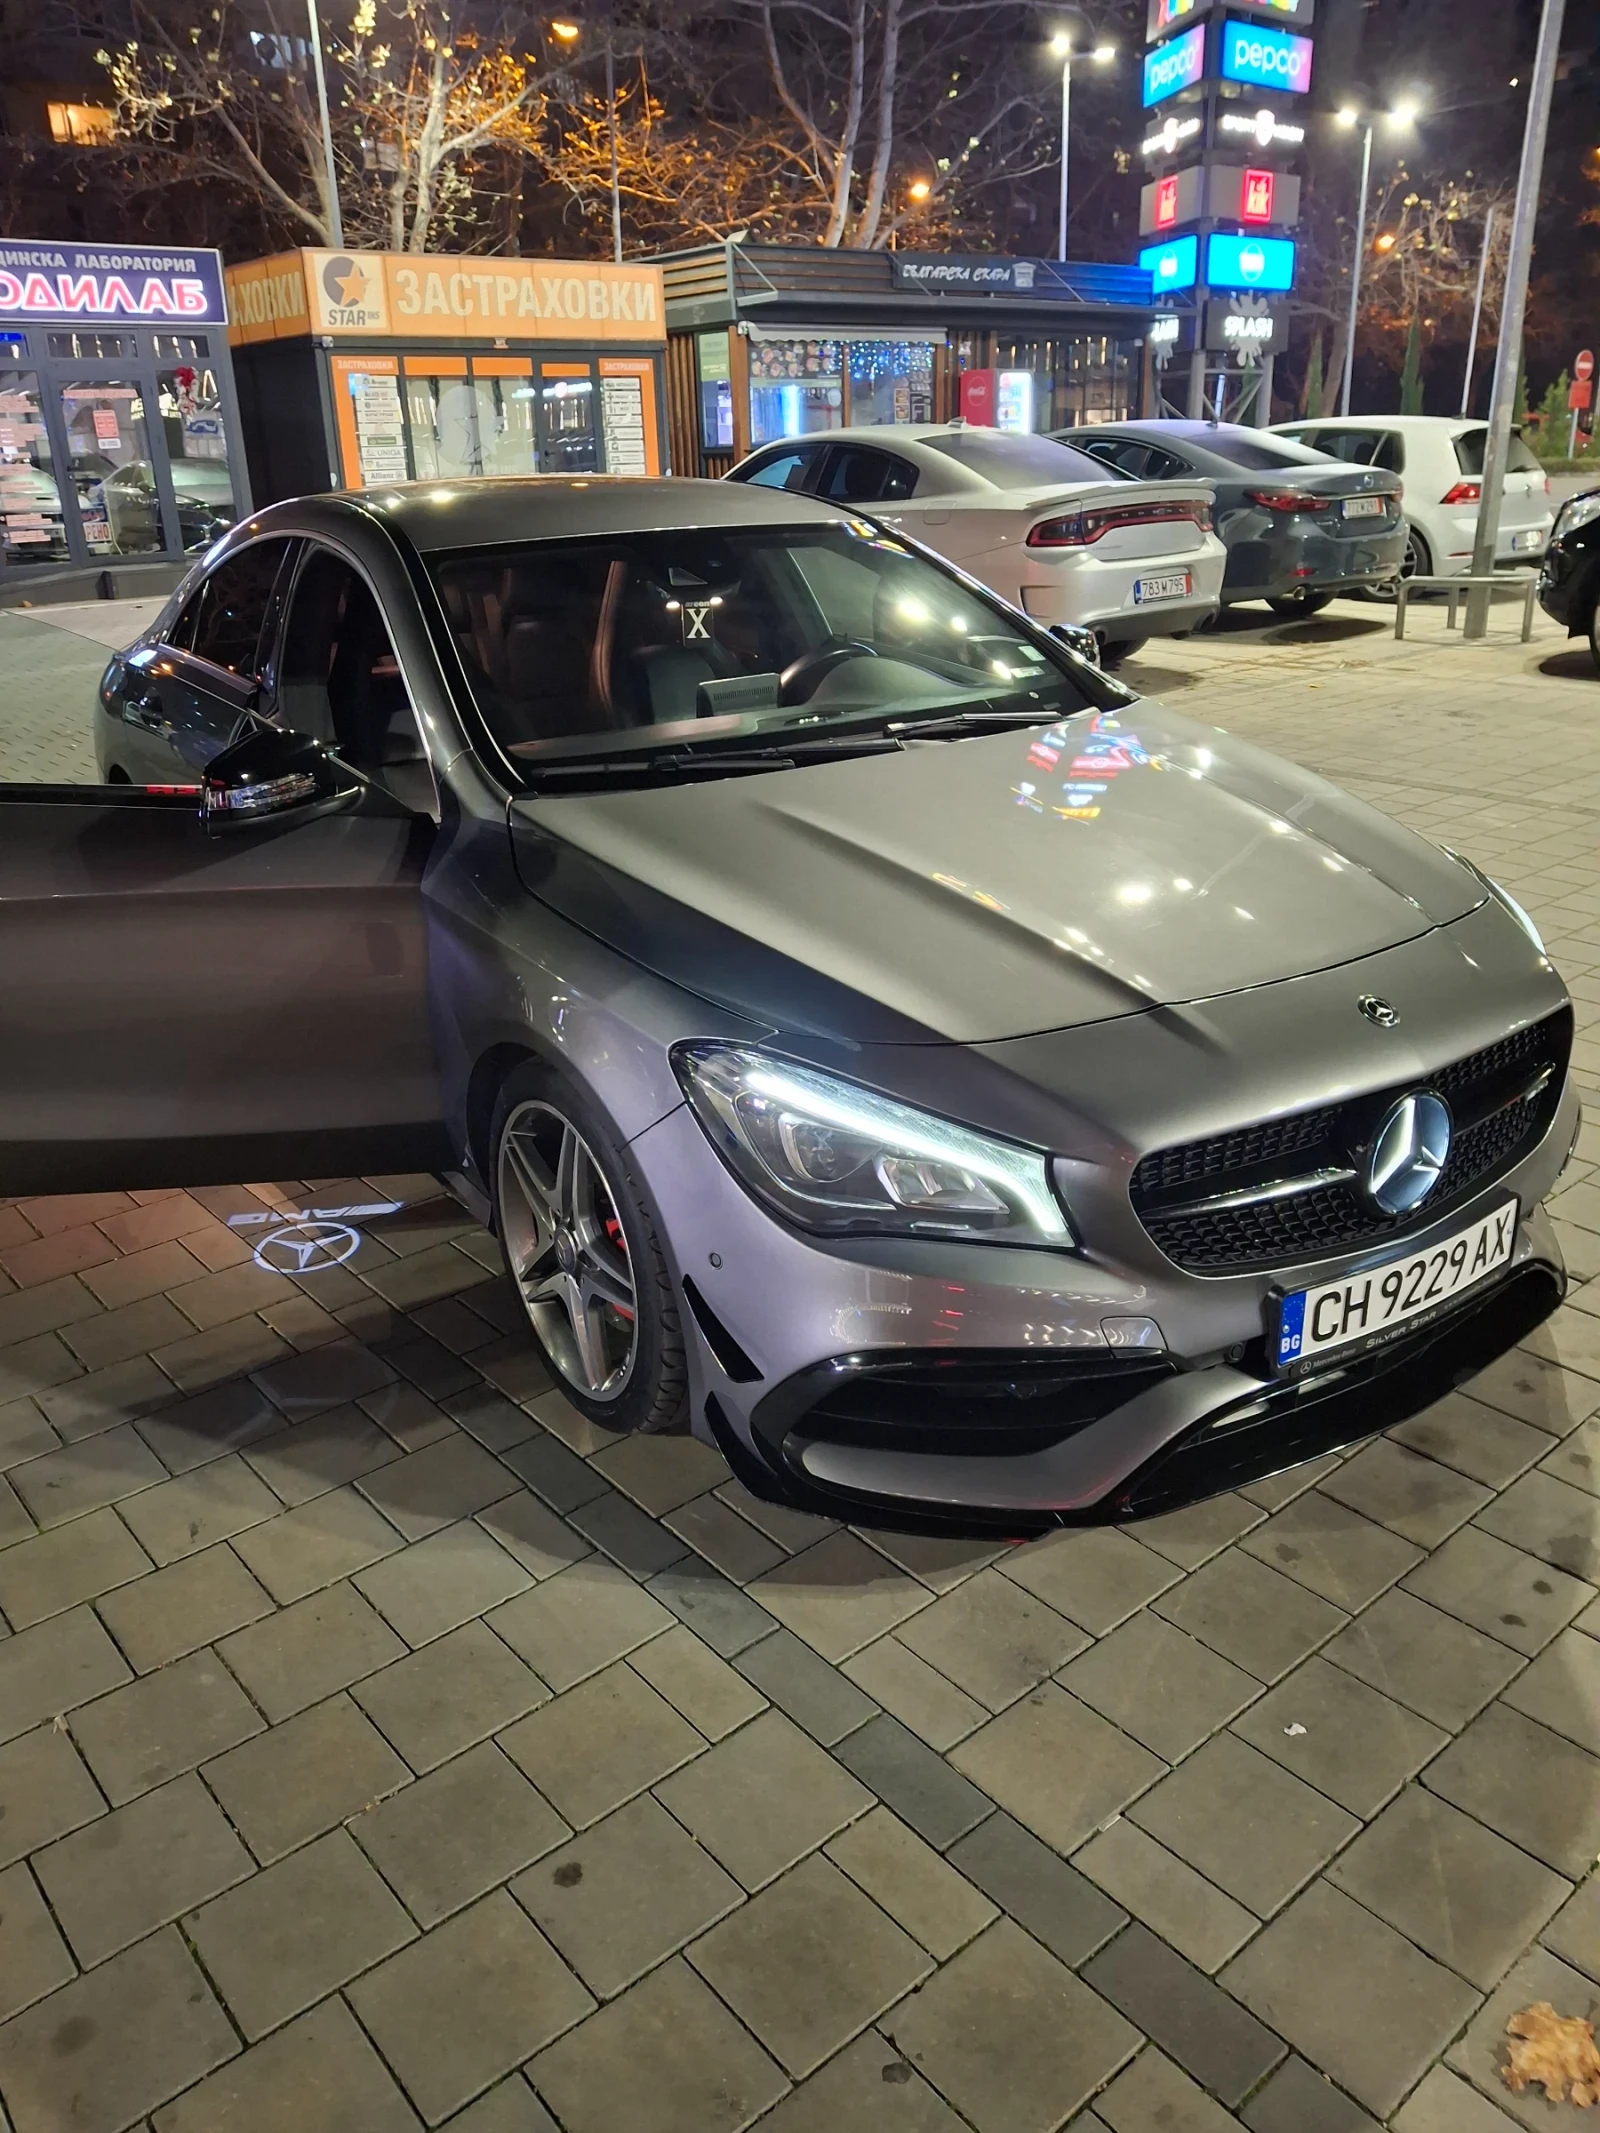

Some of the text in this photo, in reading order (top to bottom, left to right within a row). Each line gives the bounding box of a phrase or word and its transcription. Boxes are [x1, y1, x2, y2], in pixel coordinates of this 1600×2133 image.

[1150, 48, 1195, 94] pepco
[1234, 39, 1301, 76] pepco
[75, 254, 196, 272] ЛАБОРАТОРИЯ
[396, 269, 657, 322] ЗАСТРАХОВКИ
[328, 309, 366, 326] STAR
[1224, 316, 1274, 338] SPLASH
[686, 608, 711, 638] X
[1311, 1279, 1372, 1342] CH
[1381, 1239, 1468, 1320] 9229
[1470, 1210, 1511, 1275] AX
[1280, 1334, 1300, 1353] BG
[1365, 1311, 1437, 1348] SILVER STAR
